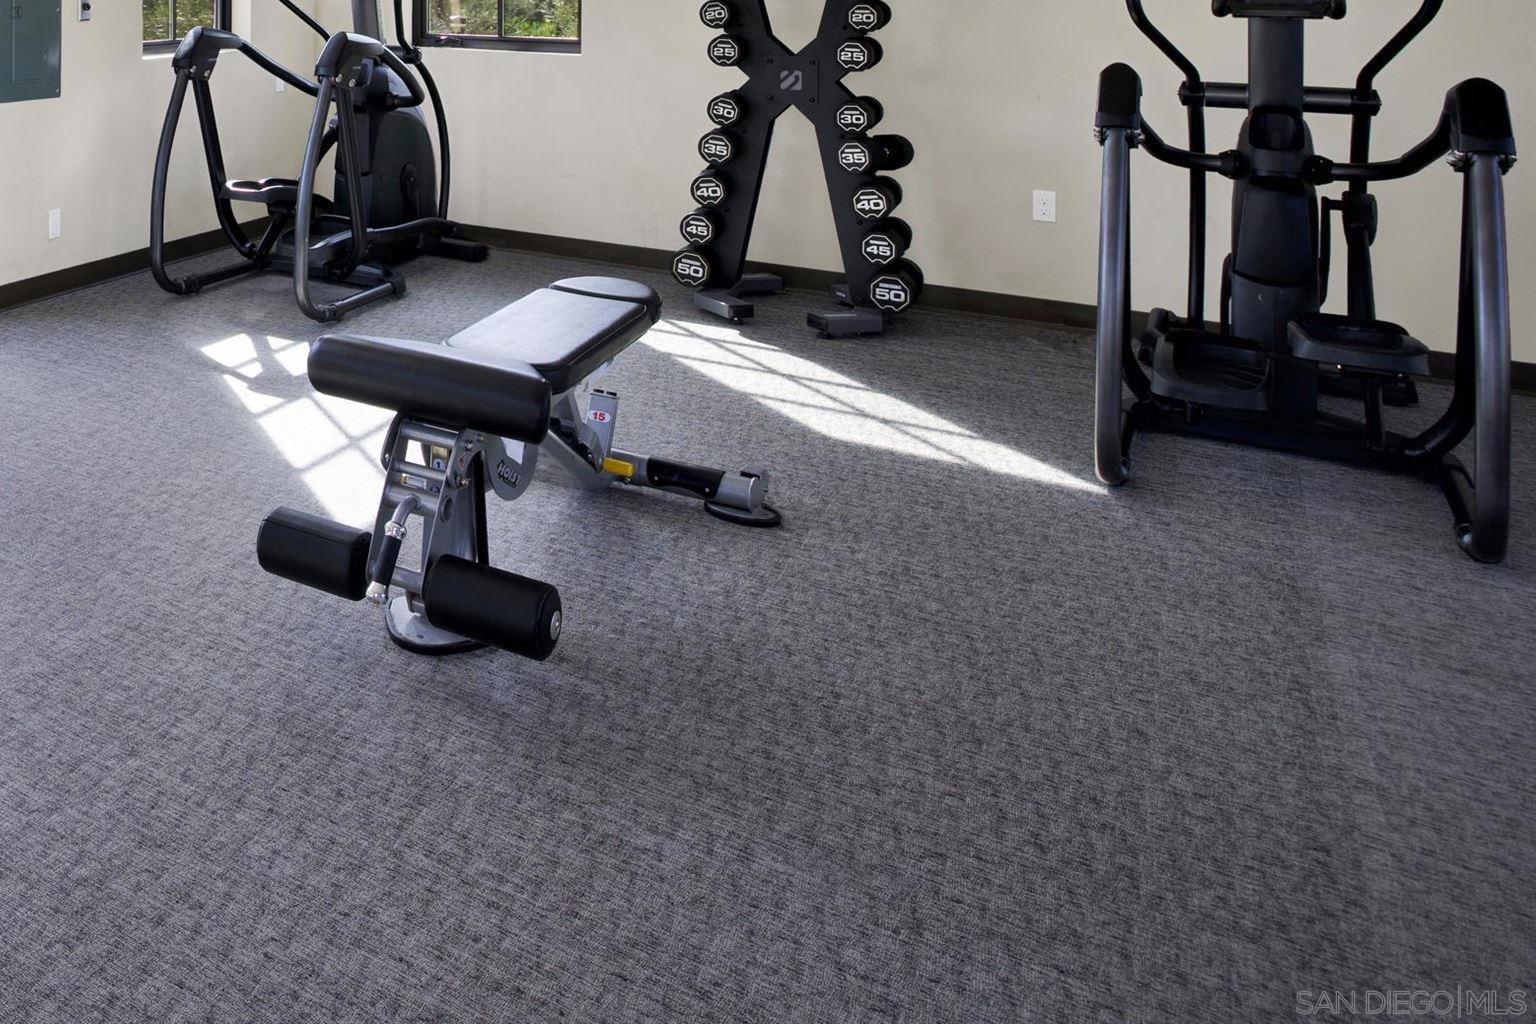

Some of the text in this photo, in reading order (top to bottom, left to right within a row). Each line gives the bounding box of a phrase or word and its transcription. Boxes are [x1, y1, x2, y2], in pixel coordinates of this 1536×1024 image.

[705, 9, 725, 20] 20
[852, 13, 874, 22] 20
[713, 47, 735, 57] 25
[840, 51, 864, 61] 25
[713, 105, 735, 118] 30
[840, 114, 864, 124] 30
[704, 143, 728, 156] 35
[841, 153, 866, 163] 35
[696, 186, 721, 197] 40
[856, 199, 884, 210] 40
[686, 225, 708, 236] 45
[866, 245, 891, 256] 45
[677, 262, 704, 278] 50
[875, 288, 906, 302] 50
[592, 411, 606, 422] 15
